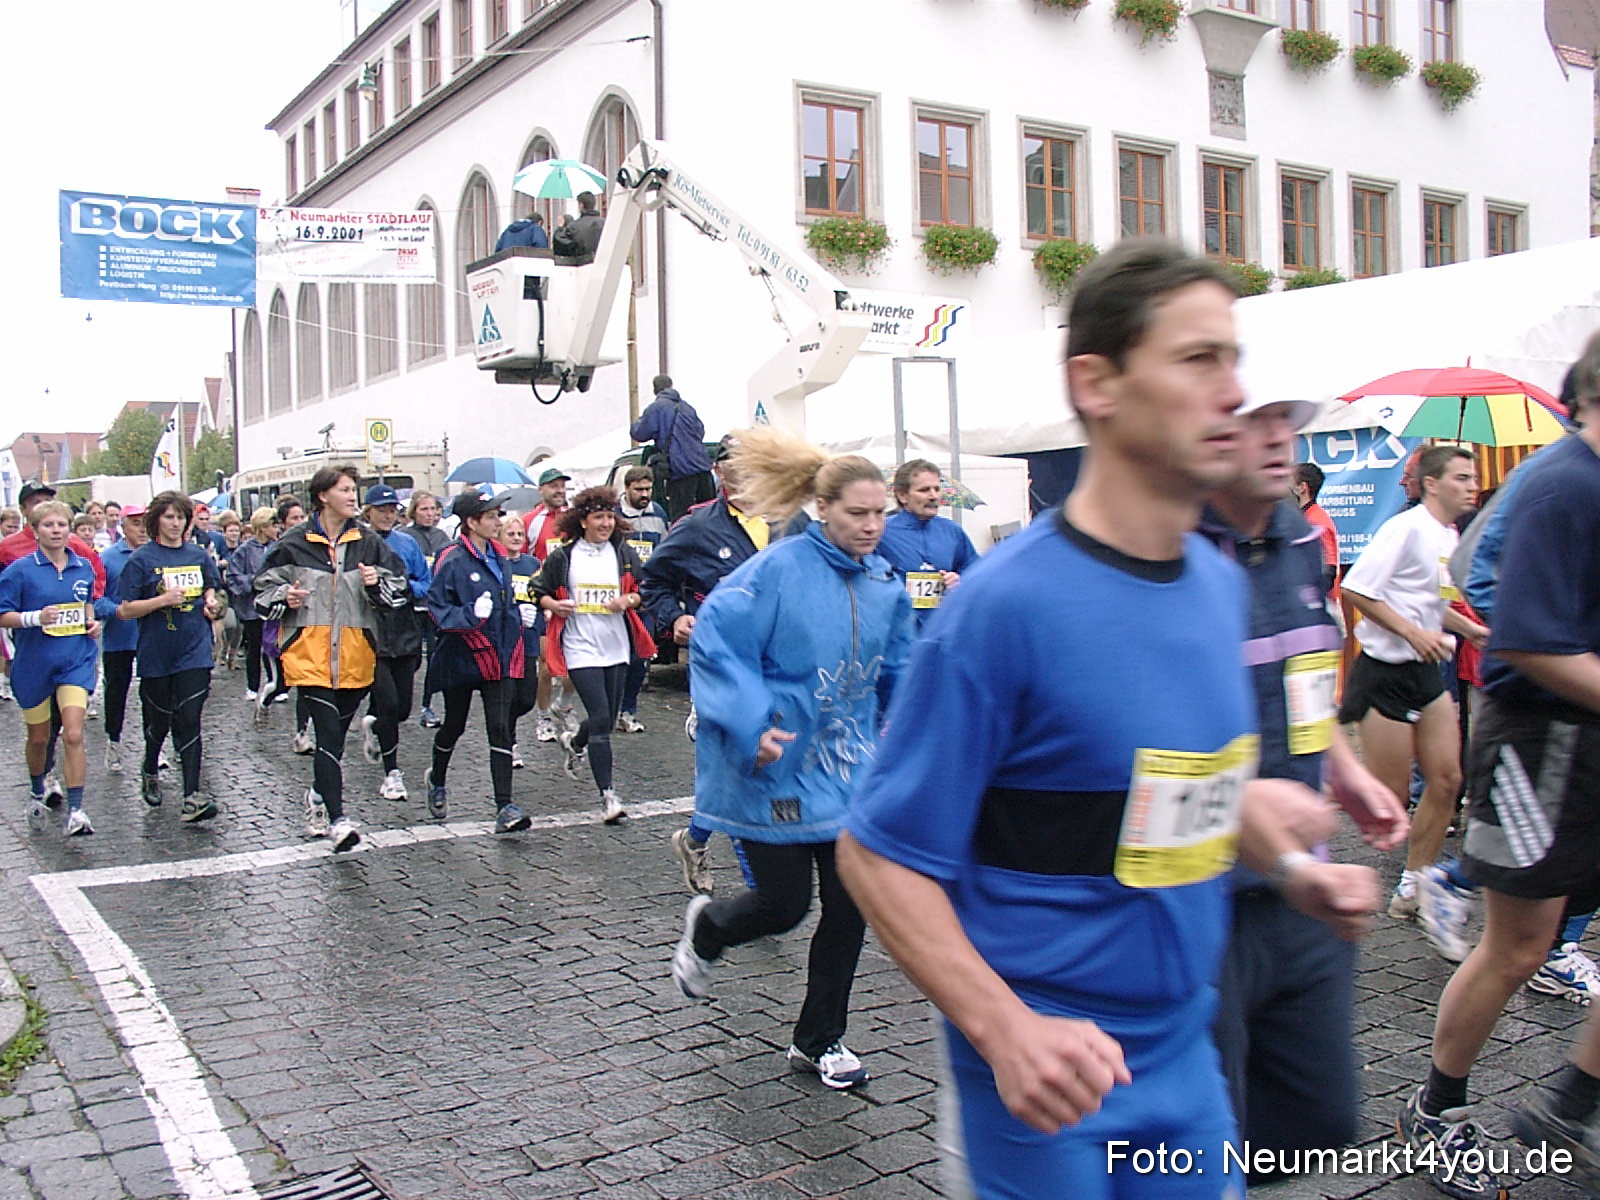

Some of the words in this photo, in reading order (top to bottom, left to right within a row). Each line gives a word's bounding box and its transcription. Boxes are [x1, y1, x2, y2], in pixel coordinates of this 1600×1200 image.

[71, 198, 244, 244] BOCK
[260, 209, 271, 220] 2.
[290, 210, 362, 224] Neumarkter
[367, 213, 432, 225] STADTLAUF
[295, 225, 364, 241] 16.9.2001
[109, 270, 145, 279] LOGISTIK
[871, 320, 900, 335] arkt
[173, 572, 200, 587] 1751
[584, 589, 616, 604] 1128
[57, 609, 80, 625] 750
